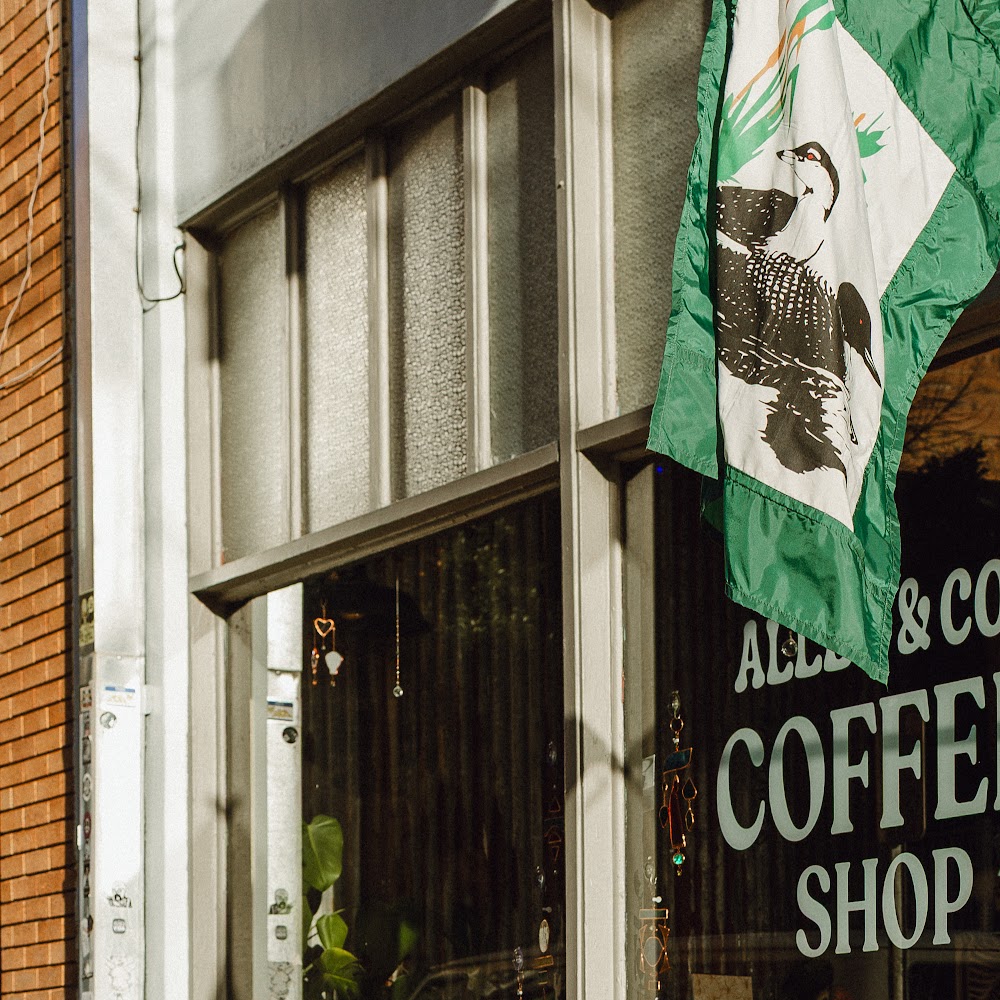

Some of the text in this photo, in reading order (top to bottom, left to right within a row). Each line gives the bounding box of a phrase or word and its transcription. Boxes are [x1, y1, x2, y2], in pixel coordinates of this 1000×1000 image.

[734, 617, 853, 694] ALL
[897, 577, 931, 655] &
[796, 846, 974, 958] SHOP
